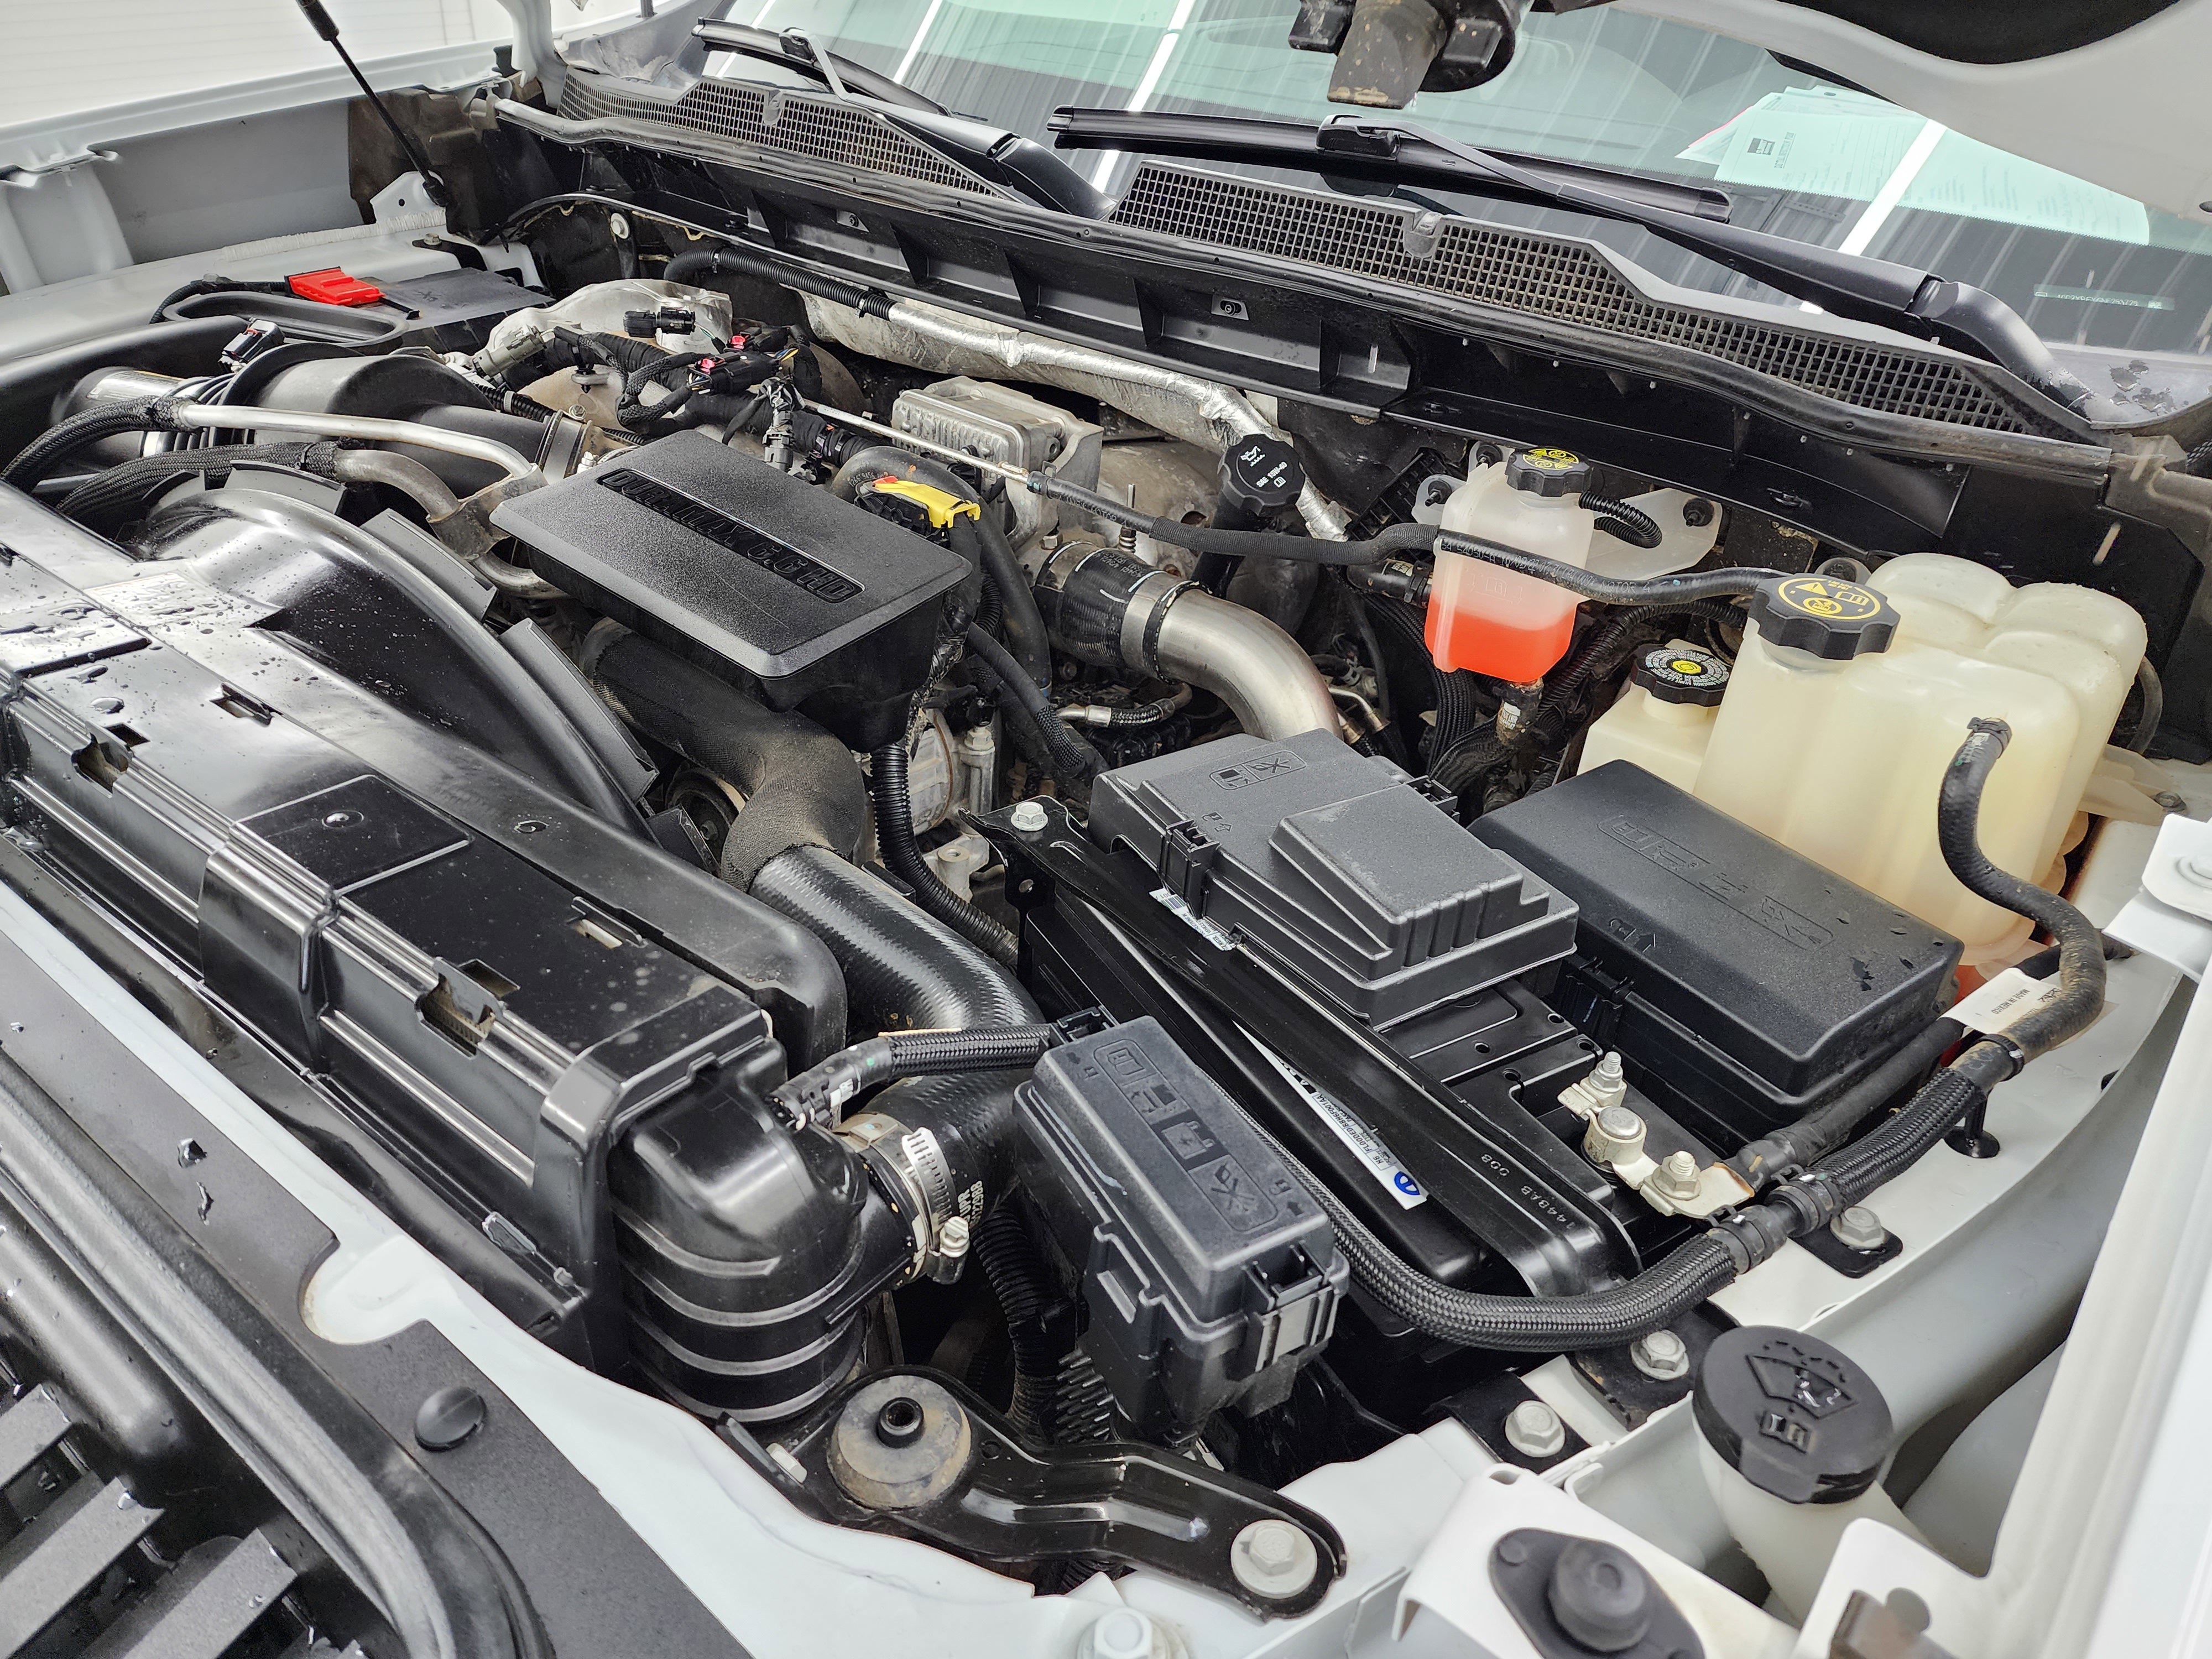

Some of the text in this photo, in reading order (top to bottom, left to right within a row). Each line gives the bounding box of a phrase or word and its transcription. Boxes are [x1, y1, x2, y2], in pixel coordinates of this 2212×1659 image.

[1256, 461, 1288, 487] SAE 15W-40
[602, 470, 855, 600] DURAMAX 6.6 HD
[2013, 988, 2031, 1000] MADE
[1990, 1000, 2012, 1015] MEXICO
[1346, 1127, 1373, 1152] FLOODED
[1373, 1155, 1384, 1165] H6
